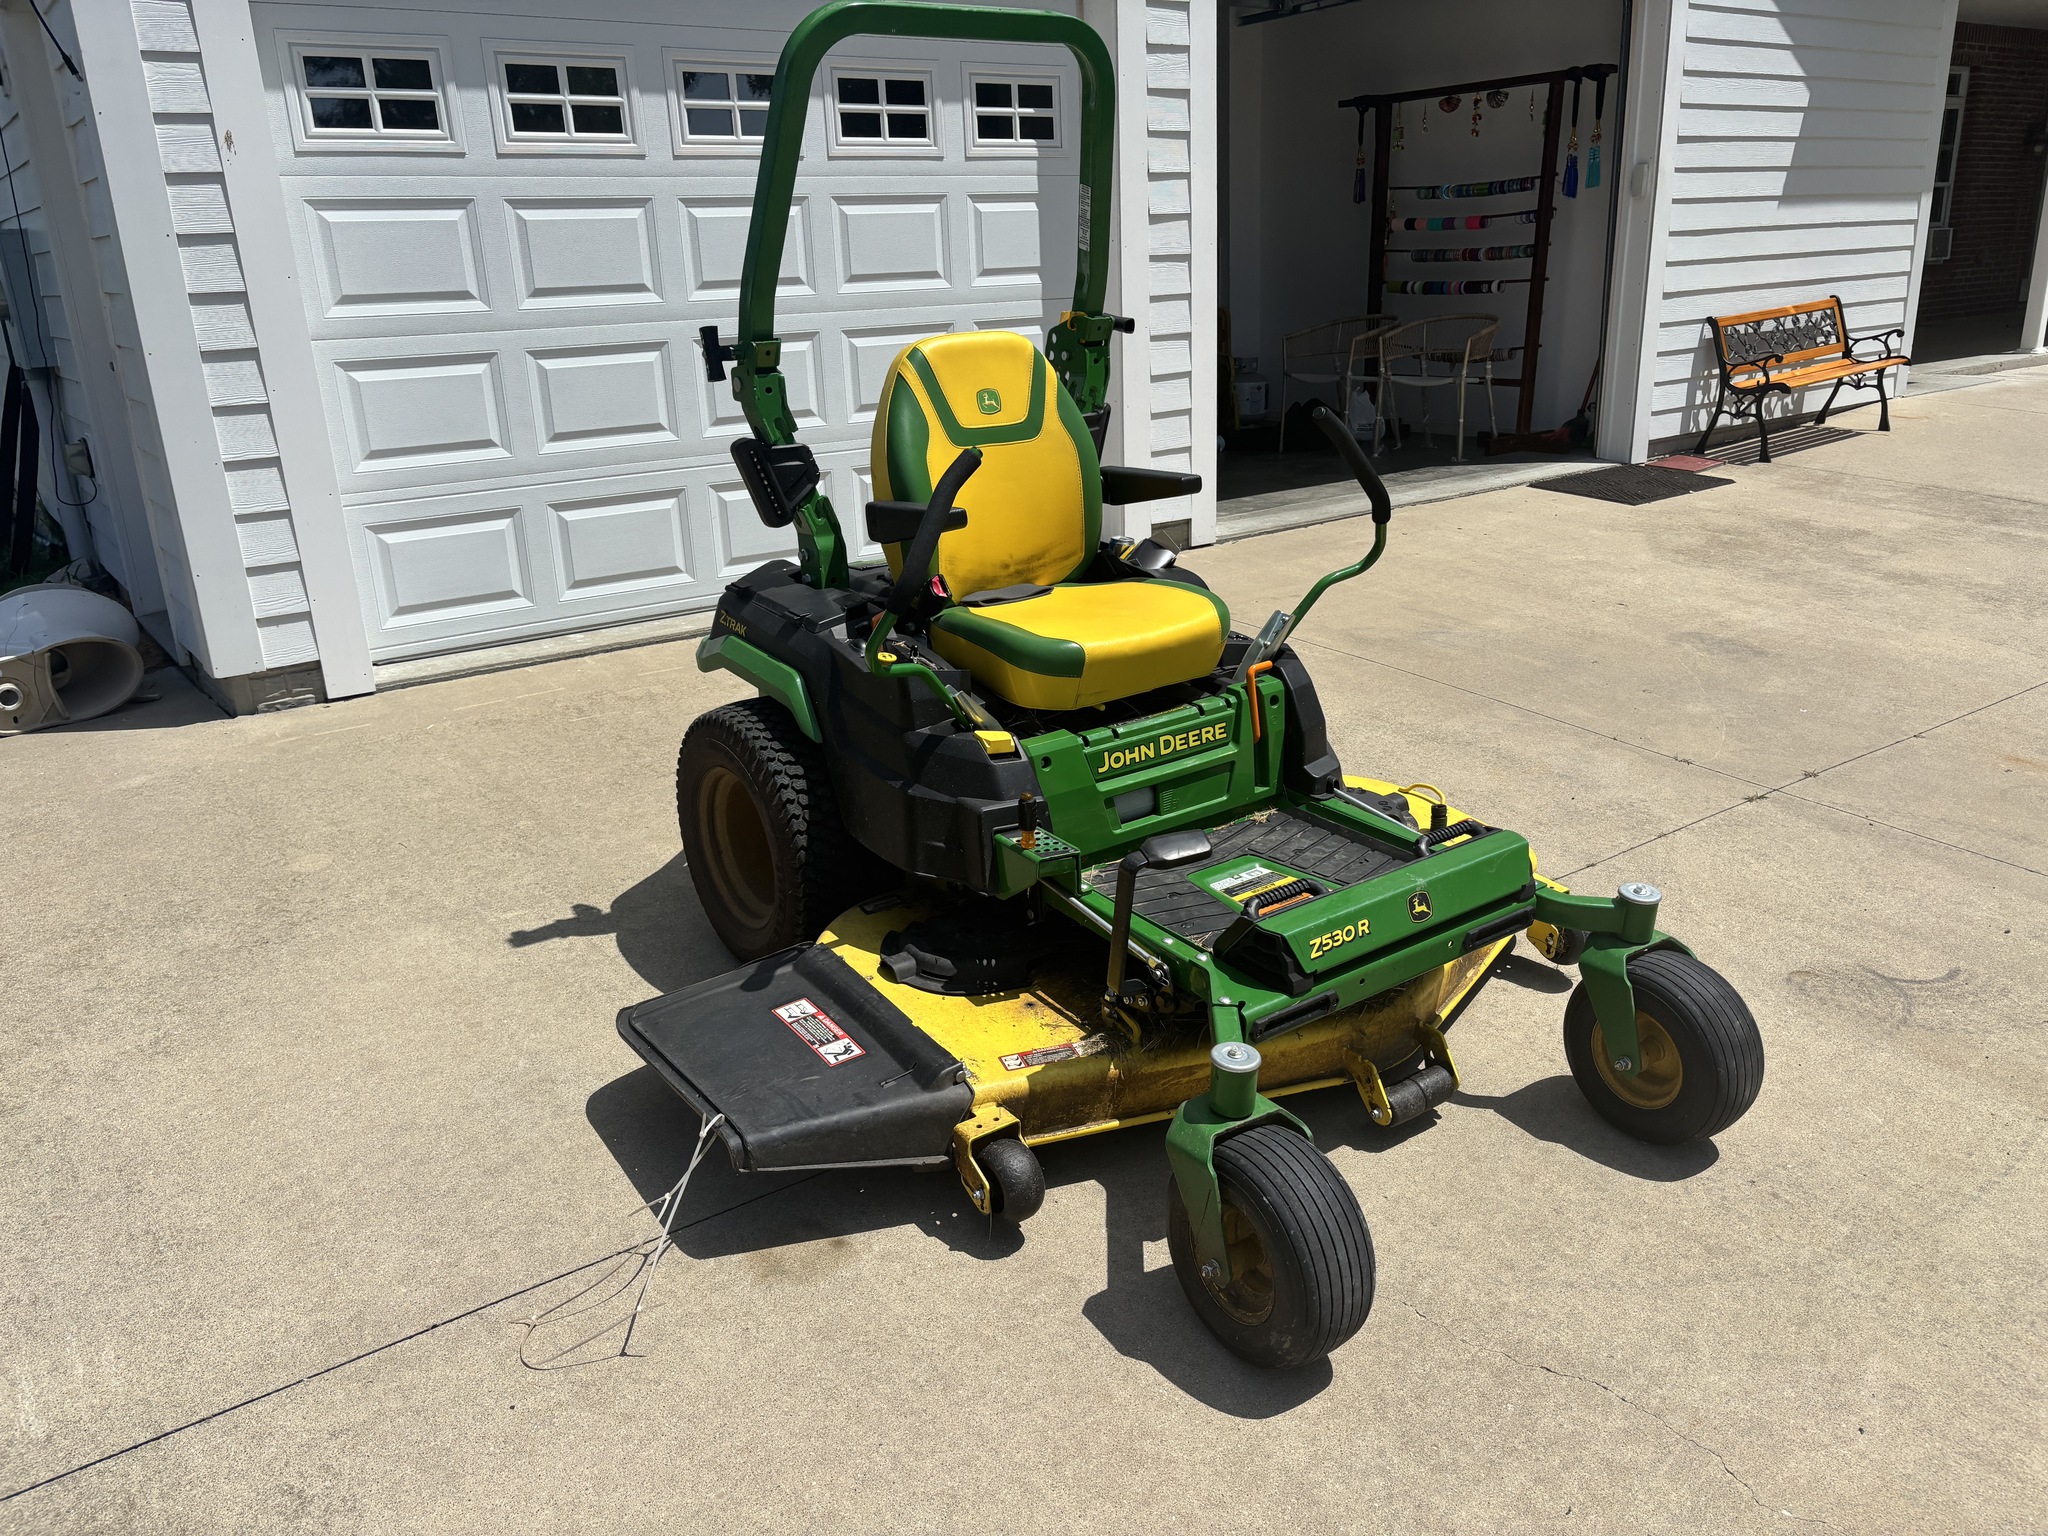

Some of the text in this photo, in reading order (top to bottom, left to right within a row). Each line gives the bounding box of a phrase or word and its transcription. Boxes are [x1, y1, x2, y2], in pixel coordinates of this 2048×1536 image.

[1098, 722, 1227, 773] JOHN DEERE
[1357, 919, 1371, 937] R
[824, 1018, 844, 1037] DANGER
